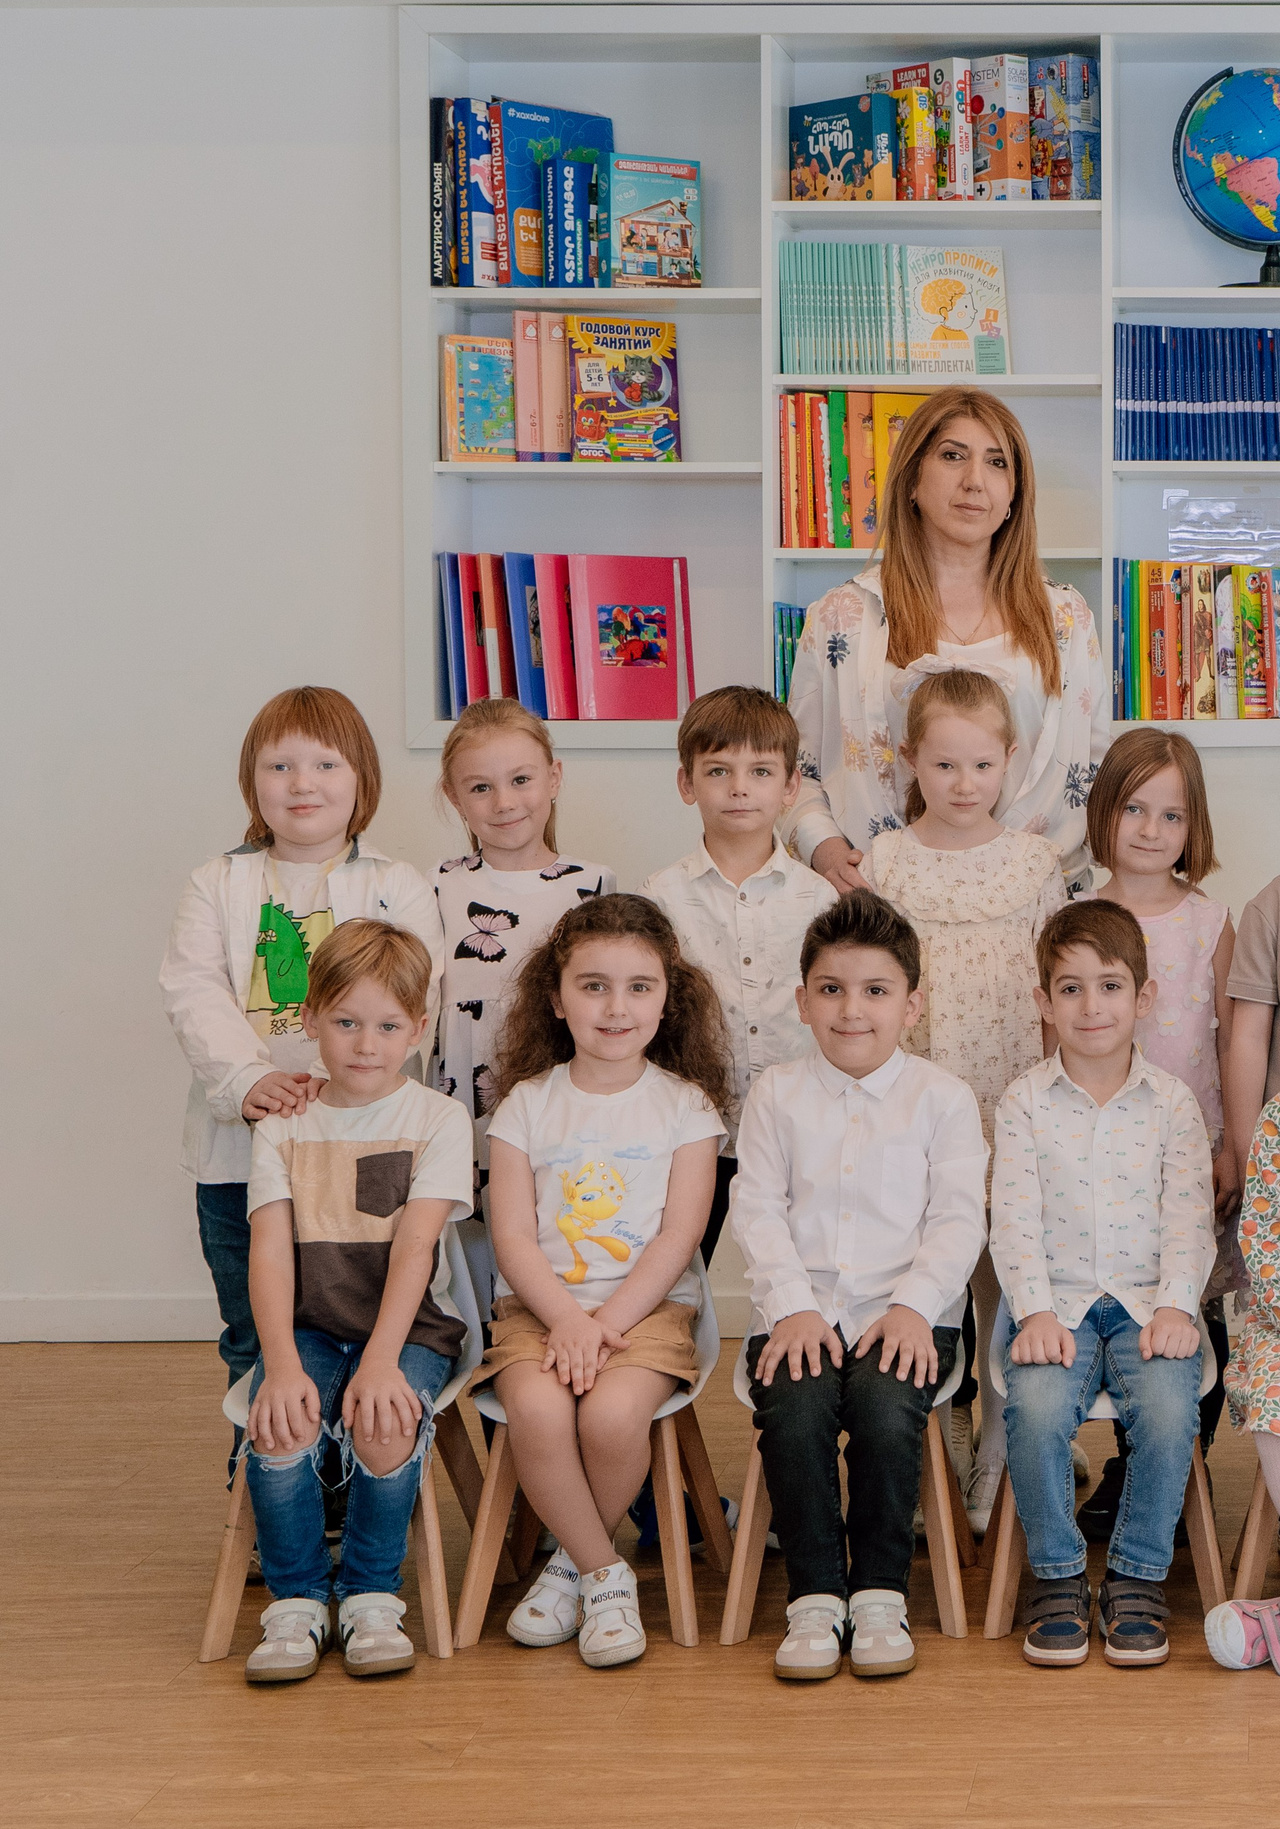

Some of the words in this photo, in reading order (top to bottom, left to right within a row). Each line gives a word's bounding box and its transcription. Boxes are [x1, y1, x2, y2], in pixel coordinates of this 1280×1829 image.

[897, 68, 916, 82] LEARN
[917, 67, 927, 78] TO
[971, 68, 1000, 81] YSTEM
[1008, 68, 1027, 76] SOLAR
[901, 79, 921, 89] COUNT
[919, 95, 927, 109] 3D
[508, 108, 550, 124] #xaxalove
[958, 125, 964, 134] TO
[808, 129, 854, 155] ՆԱՊՈ
[916, 121, 924, 165] ВРЕМЕНА
[457, 121, 467, 186] ԴՐՈՇՆԵՐ
[490, 119, 503, 186] ԴՐՈՇՆԵՐ
[434, 162, 442, 208] САРЬЯН
[494, 189, 505, 208] ԵՎ
[564, 166, 574, 231] ԶՈՒՅԳԸ
[434, 210, 443, 279] МАРТИРОС
[460, 210, 470, 264] ՔԱՐՏԵԶ
[496, 213, 508, 271] ՔԱՐՏԵԶ
[564, 236, 576, 284] ԳՏԻՐ
[909, 251, 998, 279] НЕЙРОПРОПИСИ
[915, 272, 930, 284] ДЛЯ
[934, 268, 974, 280] РАЗВИТИЯ
[976, 278, 1000, 294] МОЗГА
[580, 322, 630, 336] ГОДОВОЙ
[634, 325, 661, 338] КУРС
[487, 340, 507, 348] ՄԵՐ
[593, 335, 651, 350] ЗАНЯТИЙ
[910, 350, 942, 359] РАЗВИТИЯ
[911, 360, 974, 373] ИНТЕЛЛЕКТА!
[580, 449, 604, 457] ФГОС
[1150, 568, 1162, 578] 4-5
[270, 1018, 303, 1036] 怒っ
[544, 1564, 578, 1583] MOSCHINO
[590, 1588, 632, 1606] MOSCHINO
